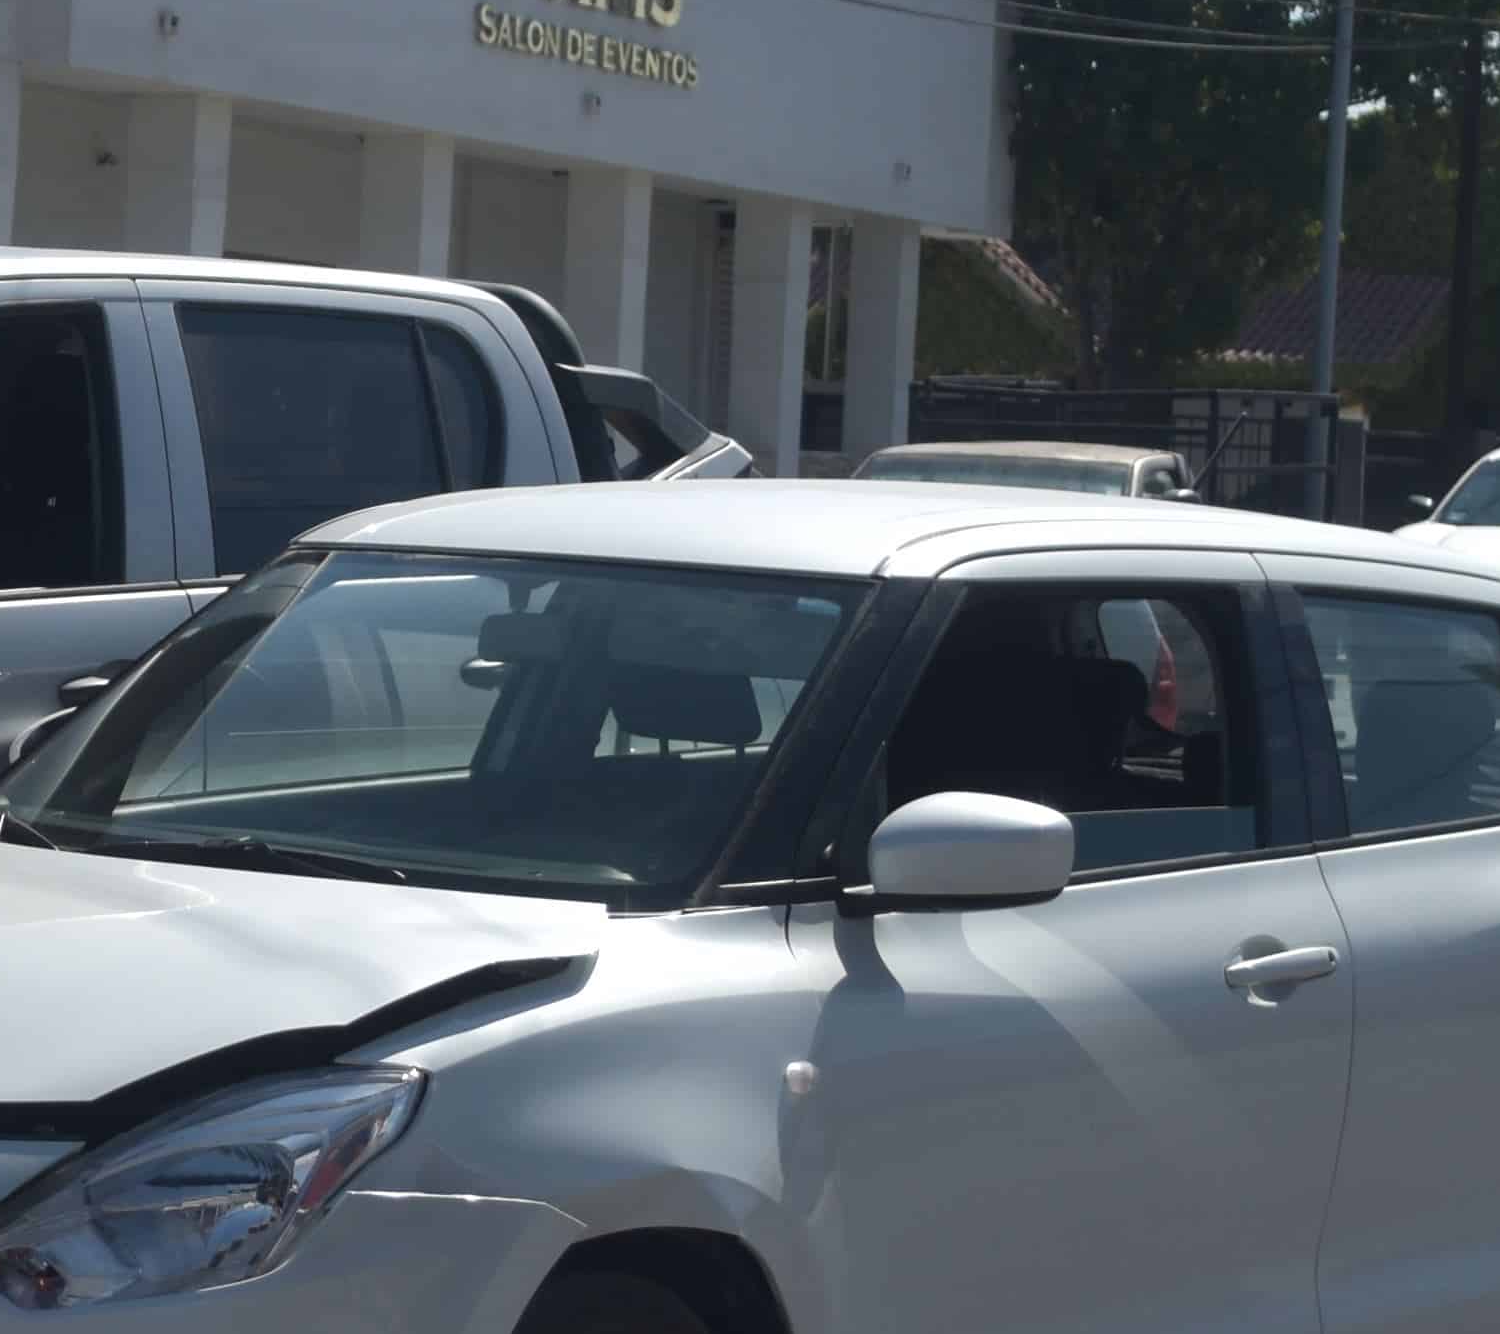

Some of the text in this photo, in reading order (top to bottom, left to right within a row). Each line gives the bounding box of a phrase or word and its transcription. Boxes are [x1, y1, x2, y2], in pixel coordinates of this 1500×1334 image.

[475, 2, 698, 88] SALON DE EVENTOS
